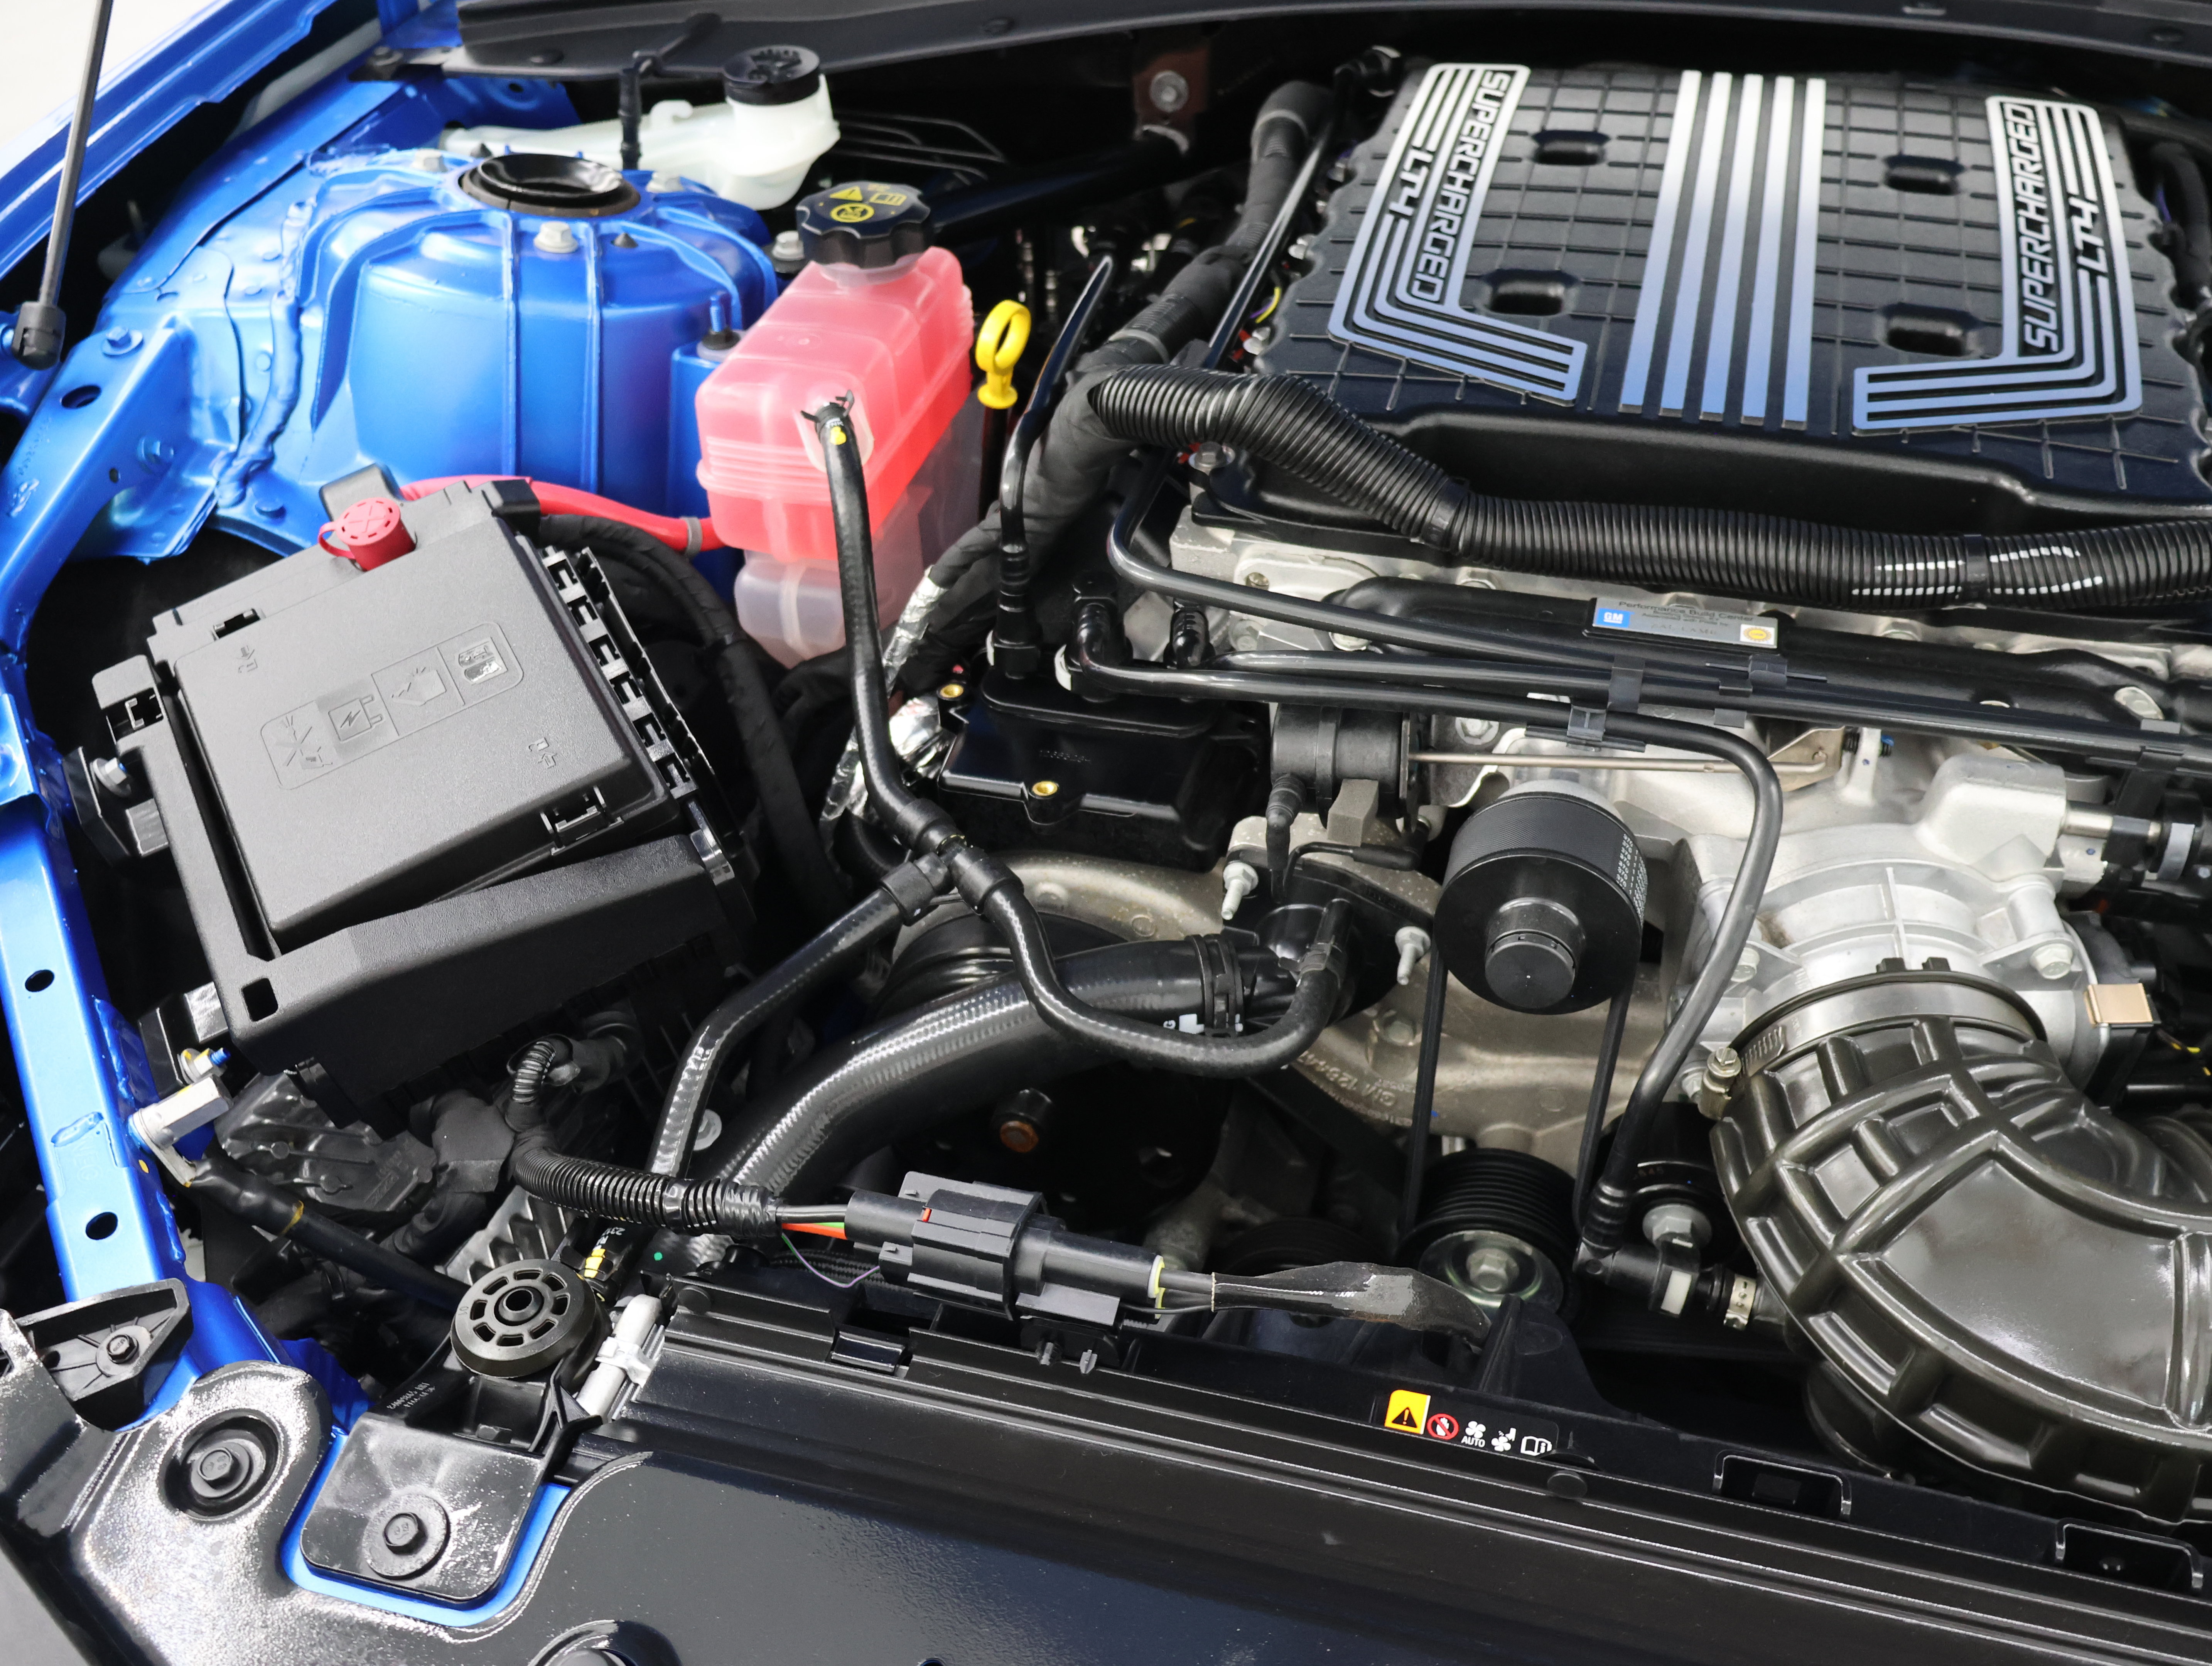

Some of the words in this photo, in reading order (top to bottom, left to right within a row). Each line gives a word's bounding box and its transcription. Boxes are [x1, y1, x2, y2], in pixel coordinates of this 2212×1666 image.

[1389, 145, 1433, 217] LT4
[1410, 70, 1513, 303] SUPERCHARGED
[2004, 102, 2059, 352] SUPERCHARGED
[2070, 196, 2108, 273] LT4
[1603, 612, 1624, 621] GM
[1619, 600, 1685, 615] Performance
[1689, 607, 1715, 619] Build
[1718, 611, 1754, 622] Center
[1461, 1436, 1485, 1447] AUTO
